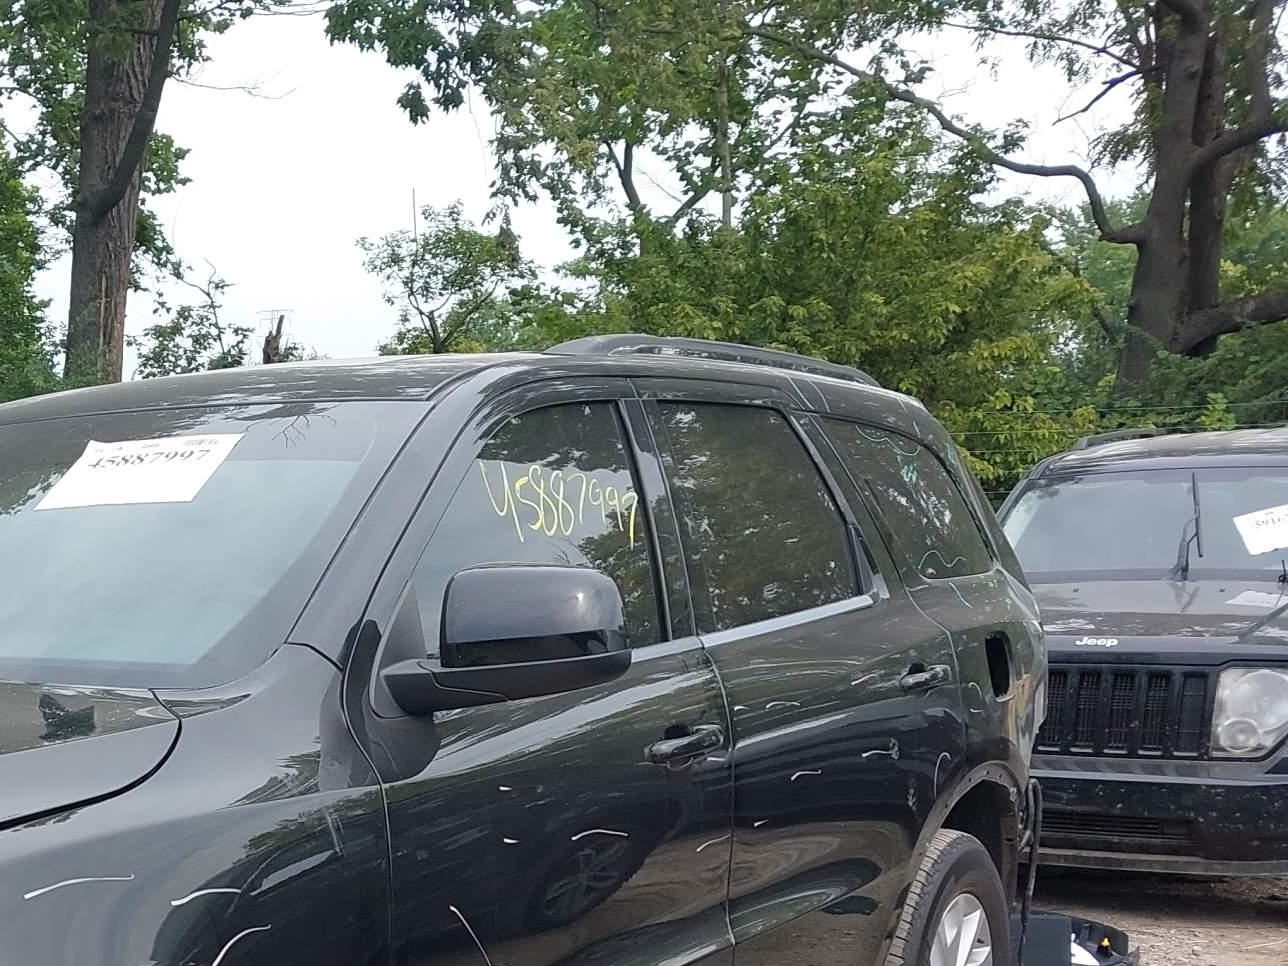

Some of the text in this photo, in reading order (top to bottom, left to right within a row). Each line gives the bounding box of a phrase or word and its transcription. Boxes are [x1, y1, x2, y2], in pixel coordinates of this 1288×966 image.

[88, 449, 212, 469] 45887997
[479, 459, 640, 551] 45887997
[1075, 636, 1119, 648] Jeep
